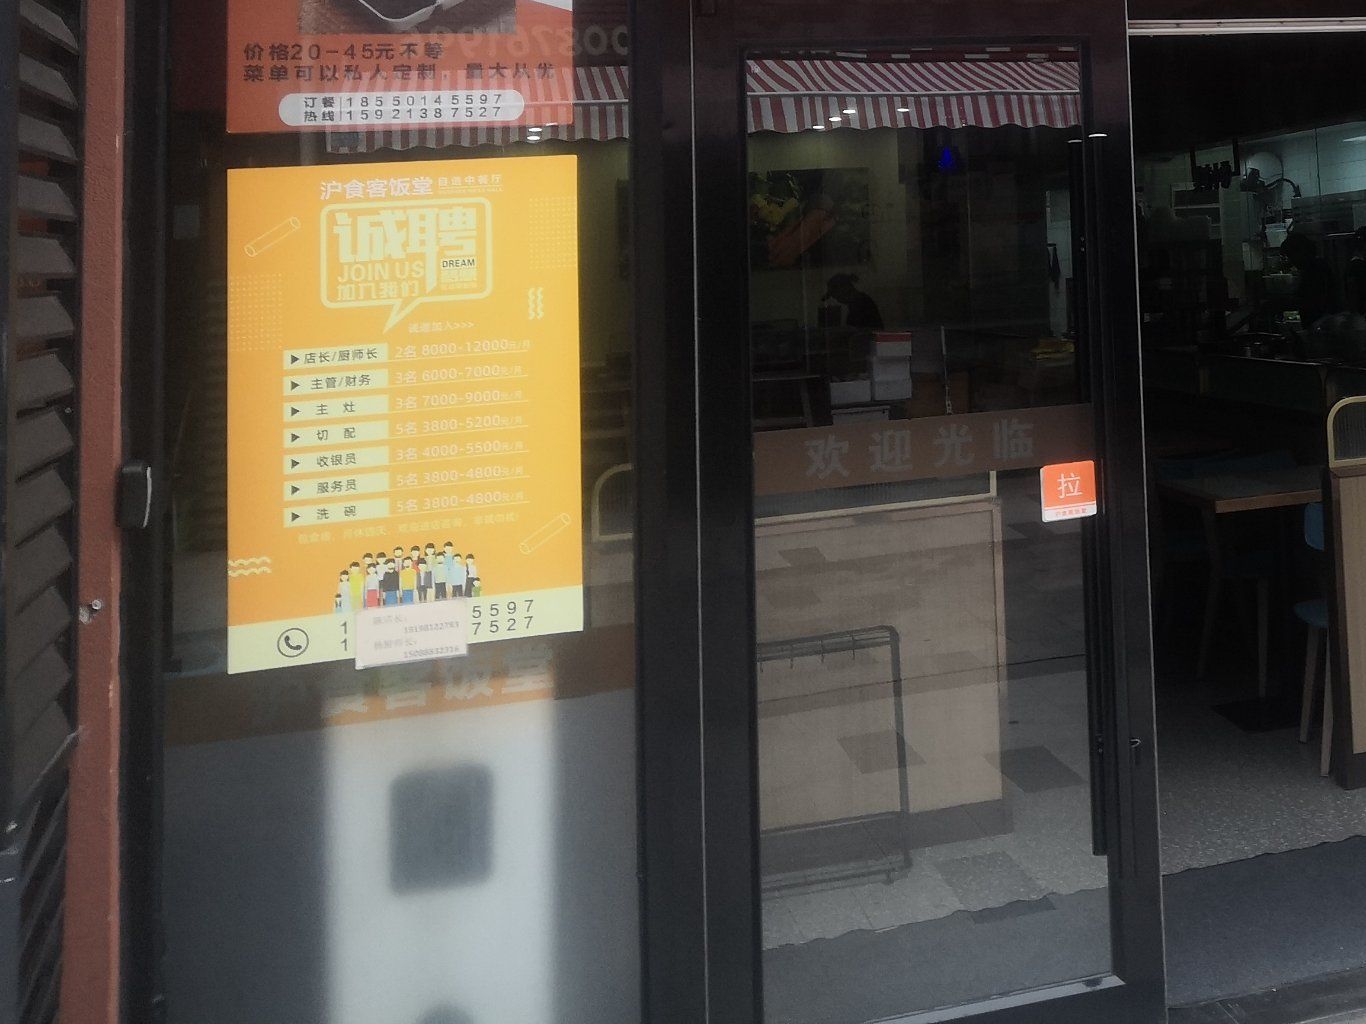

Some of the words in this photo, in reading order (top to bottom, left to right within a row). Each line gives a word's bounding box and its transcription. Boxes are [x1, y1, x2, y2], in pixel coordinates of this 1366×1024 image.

[304, 96, 335, 109] 订餐
[346, 94, 503, 109] 18550145597
[304, 110, 335, 123] 热线
[346, 106, 503, 122] 15921387527
[319, 176, 434, 201] 沪食客饭堂
[333, 206, 478, 294] 诚聘
[338, 263, 387, 282] JOIN
[394, 261, 425, 280] US
[442, 258, 476, 268] DREAM
[304, 347, 378, 365] 店长/厨师长
[311, 373, 371, 391] 主管/财务
[316, 401, 356, 416] 主灶
[316, 427, 356, 442] 切配
[805, 418, 1035, 480] 欢迎光临
[316, 453, 357, 468] 收银员
[316, 479, 357, 494] 服务员
[1056, 472, 1084, 499] 拉
[472, 600, 534, 618] 5597
[472, 616, 534, 635] 7527
